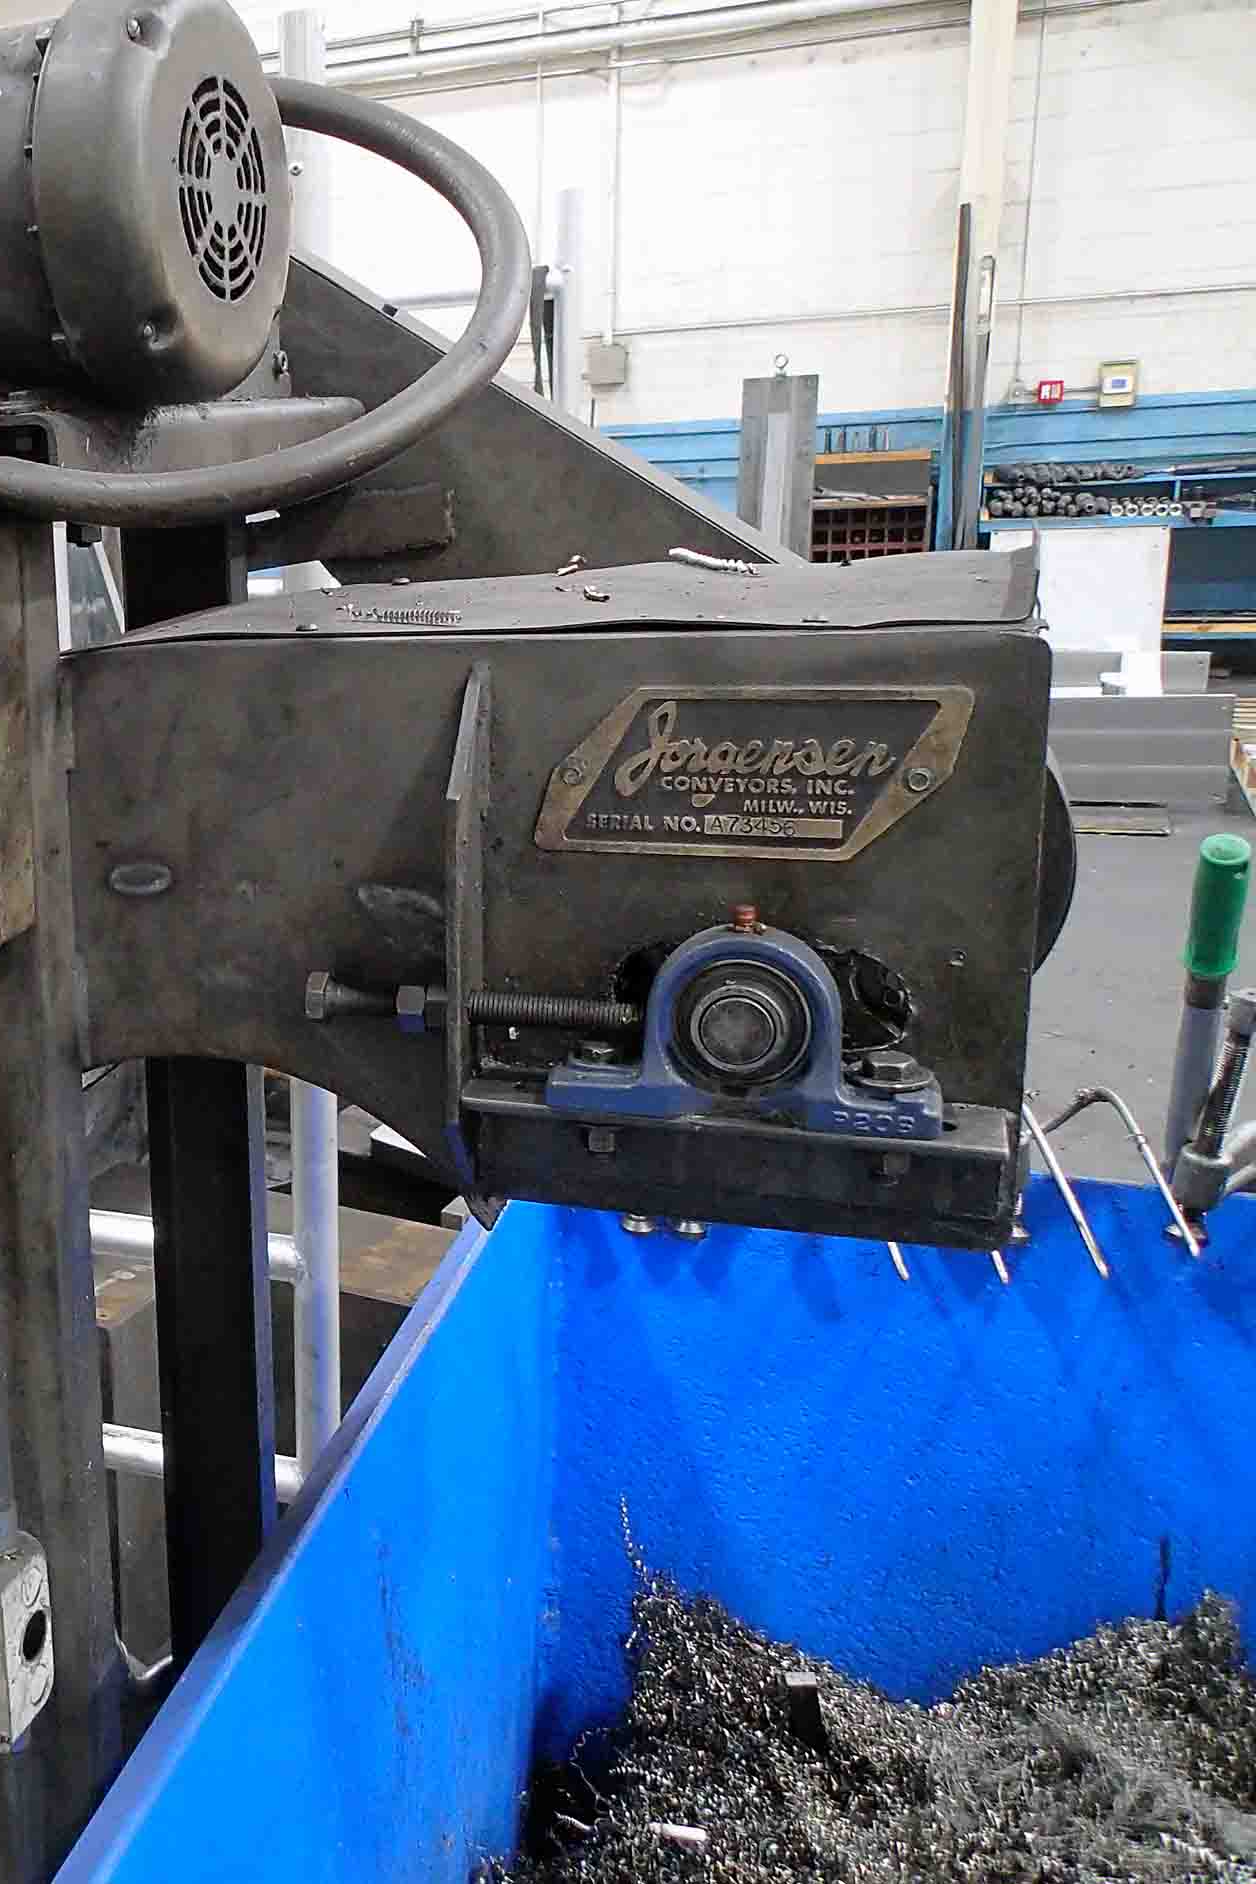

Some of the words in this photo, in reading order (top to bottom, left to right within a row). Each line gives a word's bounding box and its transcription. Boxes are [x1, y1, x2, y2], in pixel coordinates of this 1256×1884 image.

[615, 701, 895, 807] Jorgensen
[807, 779, 856, 796] INC.
[808, 801, 853, 816] WIS.
[586, 813, 654, 832] SERIAL
[663, 816, 702, 833] NO.
